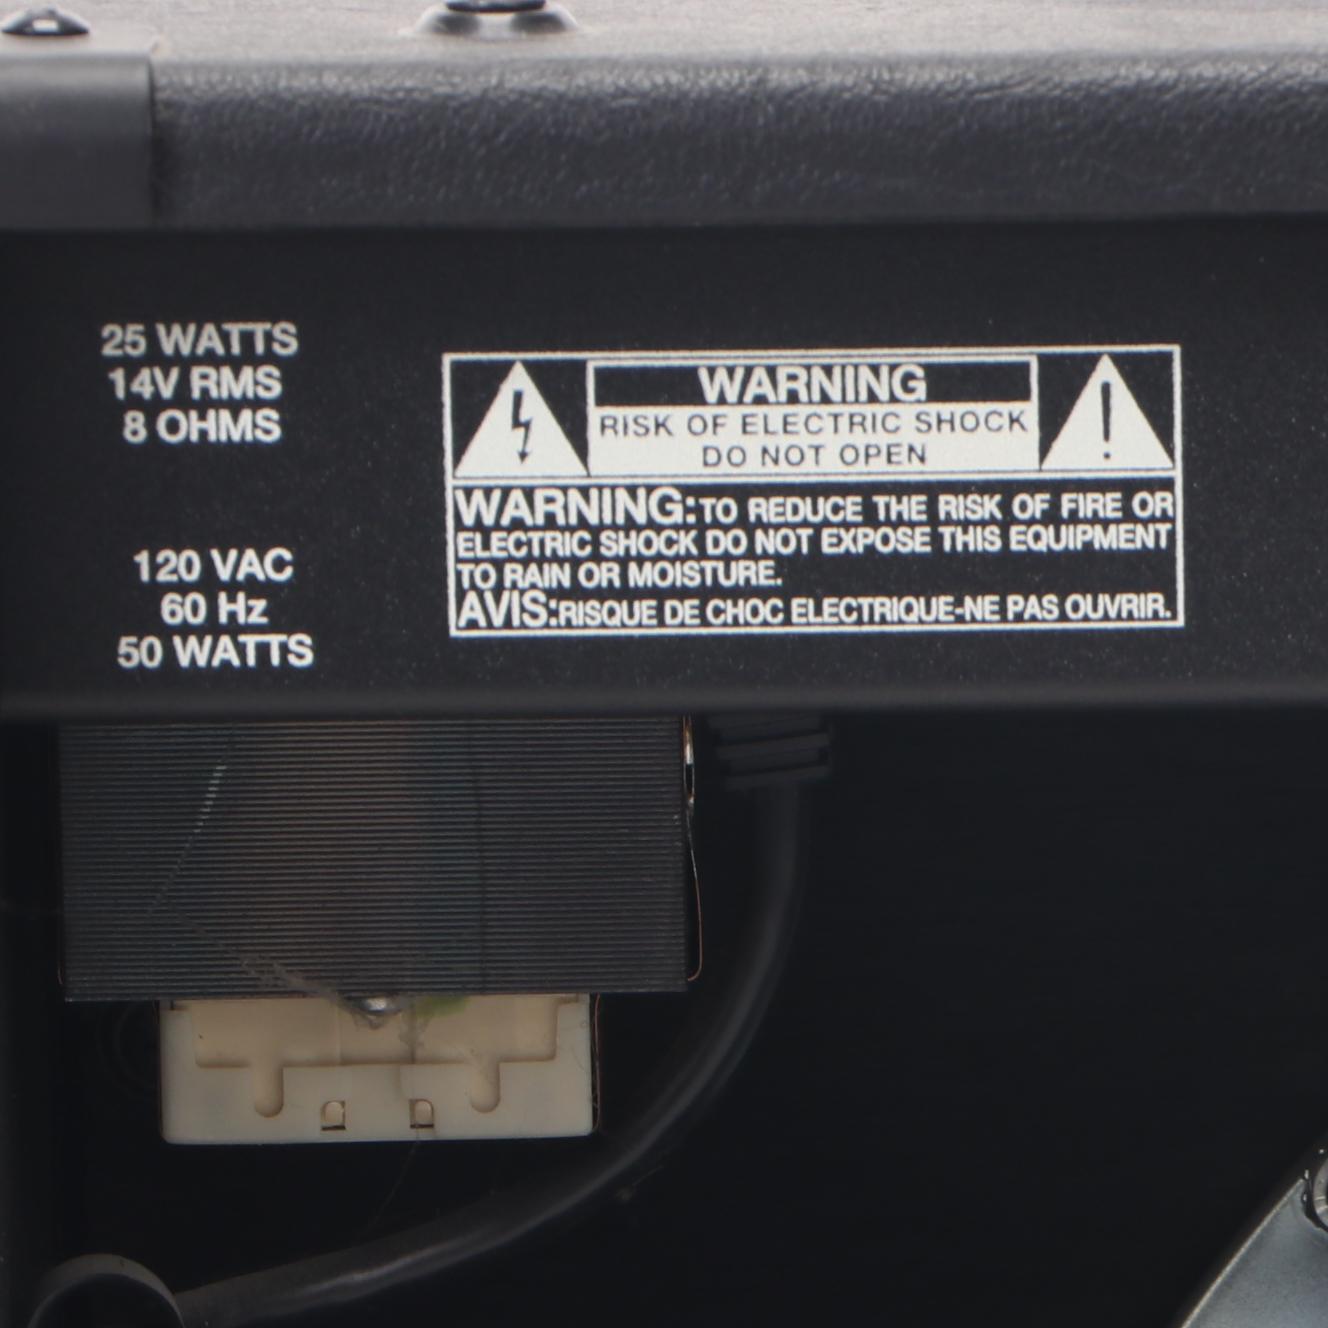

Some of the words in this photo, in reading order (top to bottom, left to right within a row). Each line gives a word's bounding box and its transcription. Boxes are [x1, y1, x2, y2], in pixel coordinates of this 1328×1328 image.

[101, 324, 147, 356] 25
[157, 322, 298, 356] WATTS
[108, 367, 180, 400] 14V
[190, 365, 283, 400] RMS
[699, 364, 927, 405] WARNING
[123, 410, 147, 443] 8
[156, 408, 282, 443] OHMS
[600, 413, 674, 437] RISK
[687, 412, 729, 435] OF
[741, 411, 901, 435] ELECTRIC
[915, 410, 1028, 433] SHOCK
[703, 445, 747, 467] DO
[761, 444, 825, 466] NOT
[840, 443, 927, 466] OPEN
[749, 496, 863, 523] REDUCE
[872, 496, 927, 521] THE
[938, 494, 1001, 521] RISK
[1012, 493, 1050, 519] OF
[1061, 492, 1121, 519] FIRE
[1132, 491, 1174, 518] OR
[456, 531, 592, 558] ELECTRIC
[599, 529, 698, 558] SHOCK
[706, 528, 747, 556] DO
[755, 528, 813, 555] NOT
[820, 527, 931, 554] EXPOSE
[938, 525, 1001, 552] THIS
[1010, 523, 1173, 552] EQUIPMENT
[133, 548, 200, 583] 120
[210, 547, 293, 582] VAC
[456, 563, 496, 589] TO
[503, 563, 570, 589] RAIN
[578, 562, 620, 588] OR
[628, 559, 782, 588] MOISTURE.
[160, 593, 206, 625] 60
[218, 592, 268, 625] Hz
[664, 600, 701, 626] DE
[706, 598, 784, 626] CHOC
[1006, 595, 1059, 621] PAS
[1065, 592, 1172, 620] OUVRIR.
[117, 636, 161, 668] 50
[173, 633, 314, 668] WATTS
